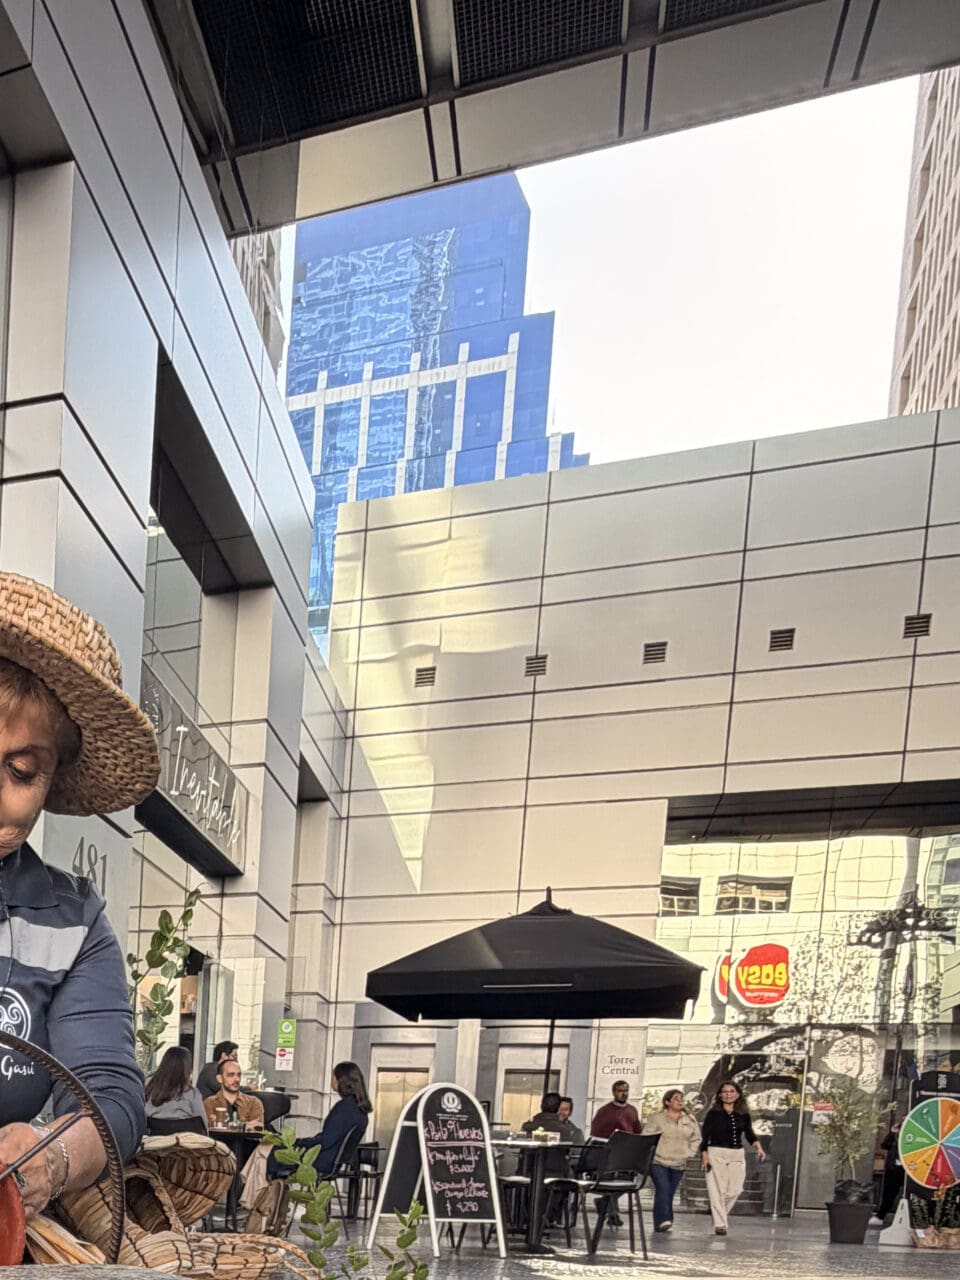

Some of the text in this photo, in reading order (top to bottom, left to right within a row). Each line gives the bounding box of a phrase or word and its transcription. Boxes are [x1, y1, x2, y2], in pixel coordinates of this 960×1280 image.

[72, 836, 107, 898] 481
[608, 1054, 636, 1065] Torre
[601, 1065, 639, 1075] Central
